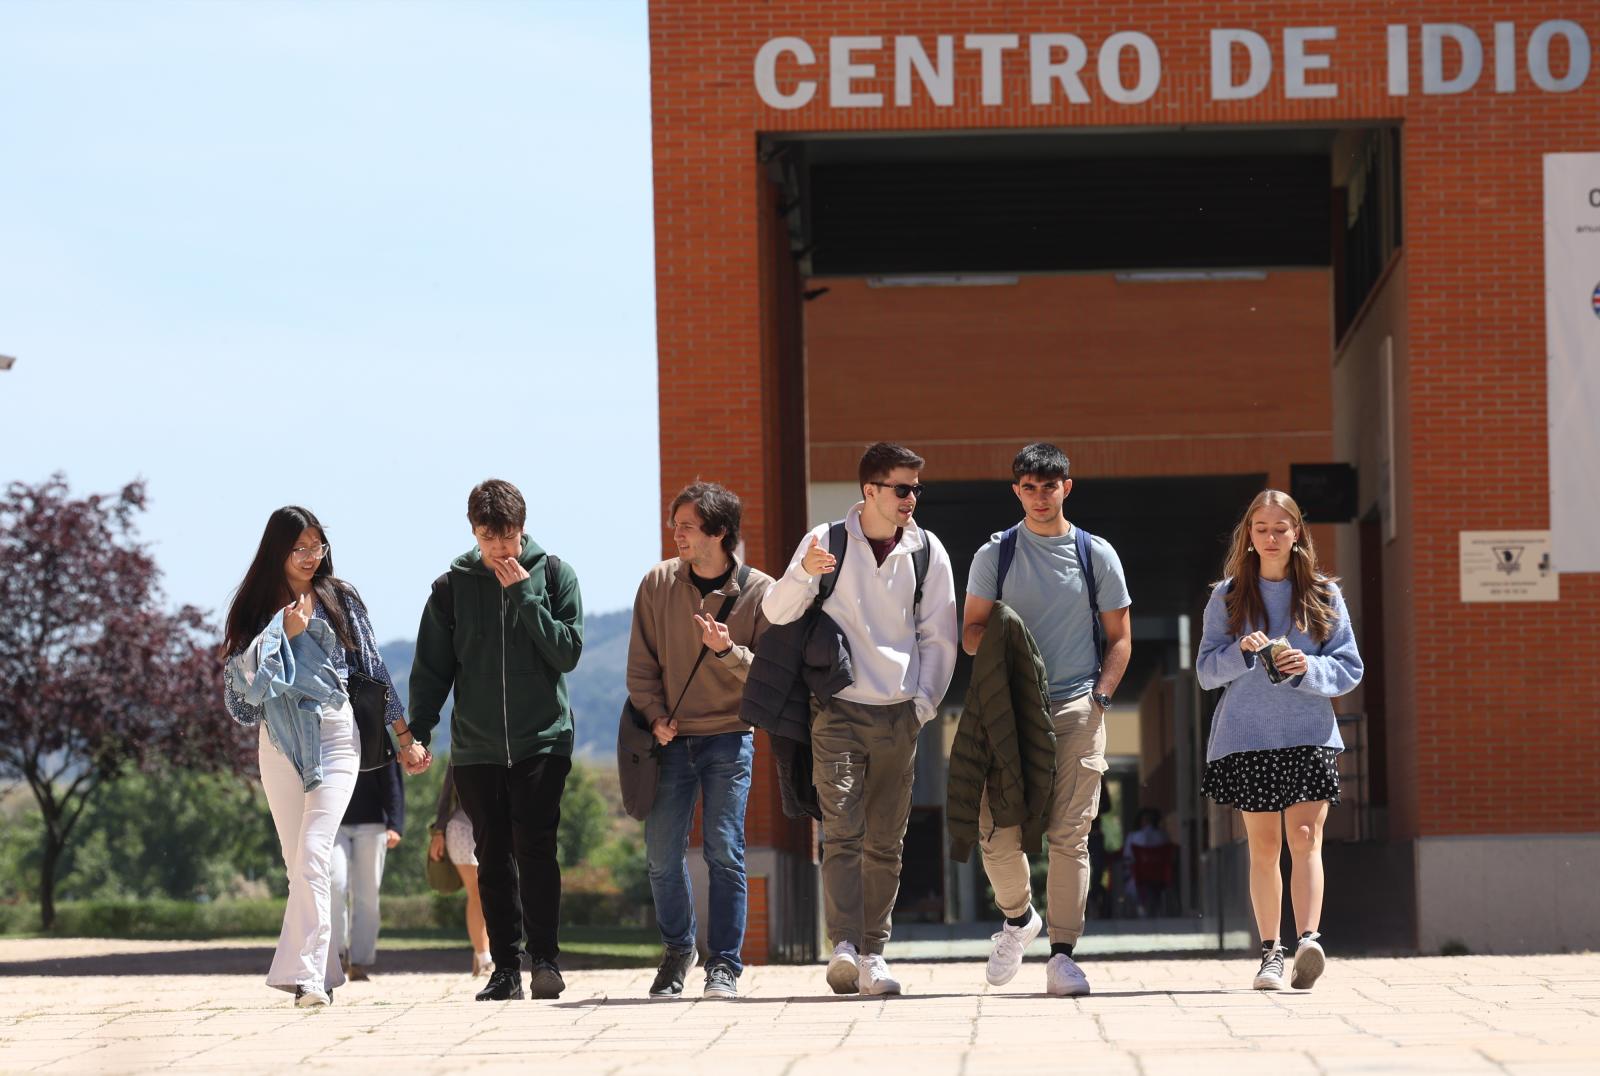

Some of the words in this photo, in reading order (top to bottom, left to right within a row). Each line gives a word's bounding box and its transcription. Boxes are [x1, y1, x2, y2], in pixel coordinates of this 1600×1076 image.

[753, 31, 1161, 109] CENTRO
[1210, 26, 1338, 99] DE
[1387, 19, 1591, 96] IDIO
